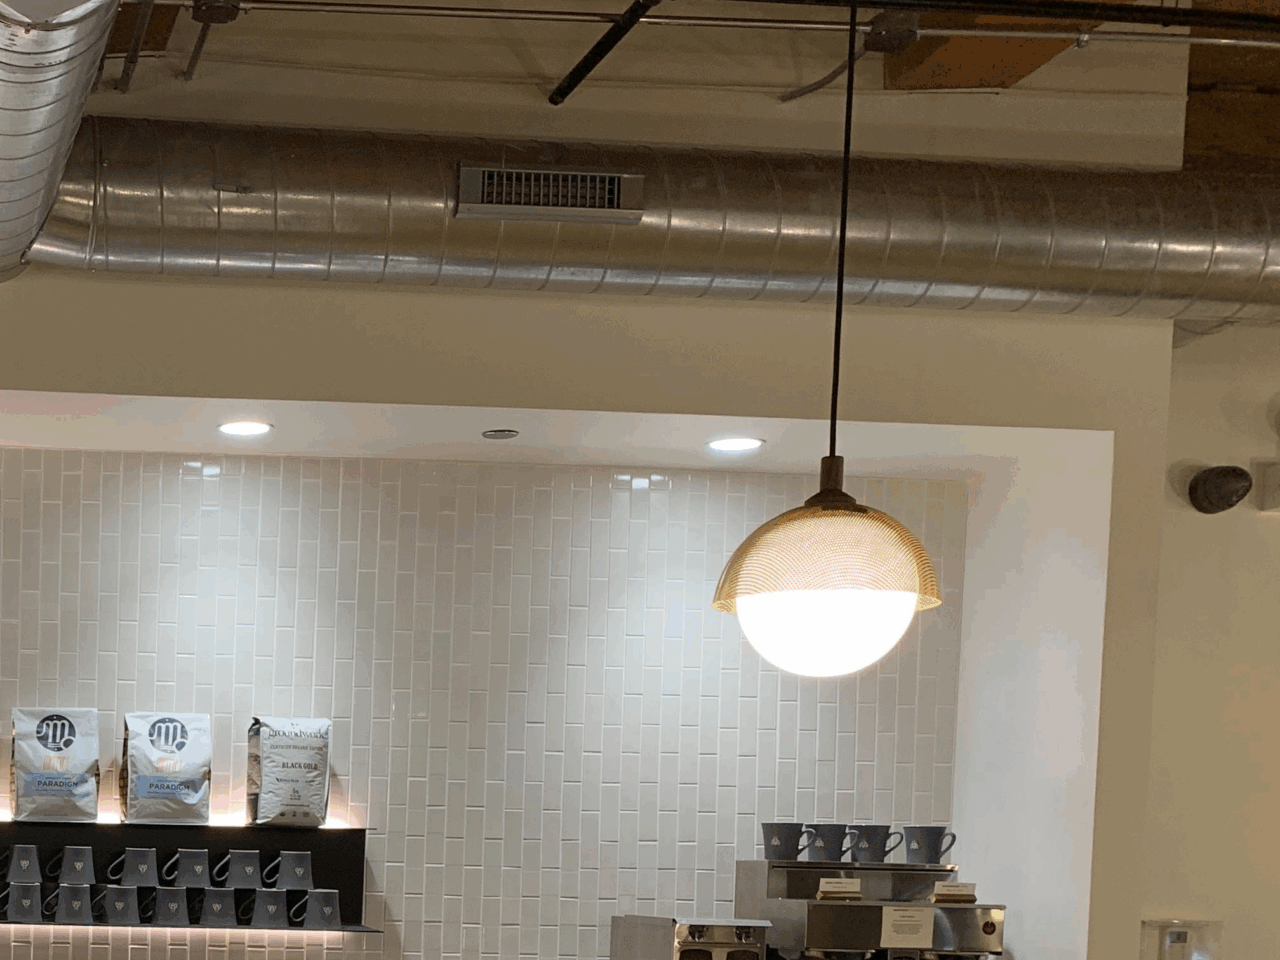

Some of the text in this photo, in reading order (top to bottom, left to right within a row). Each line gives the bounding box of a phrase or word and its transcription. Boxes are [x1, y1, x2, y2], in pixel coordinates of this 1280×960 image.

[268, 729, 325, 739] groundwork
[303, 762, 318, 770] GOLD
[37, 780, 79, 788] PARADIGM
[149, 783, 190, 791] PARADIGM
